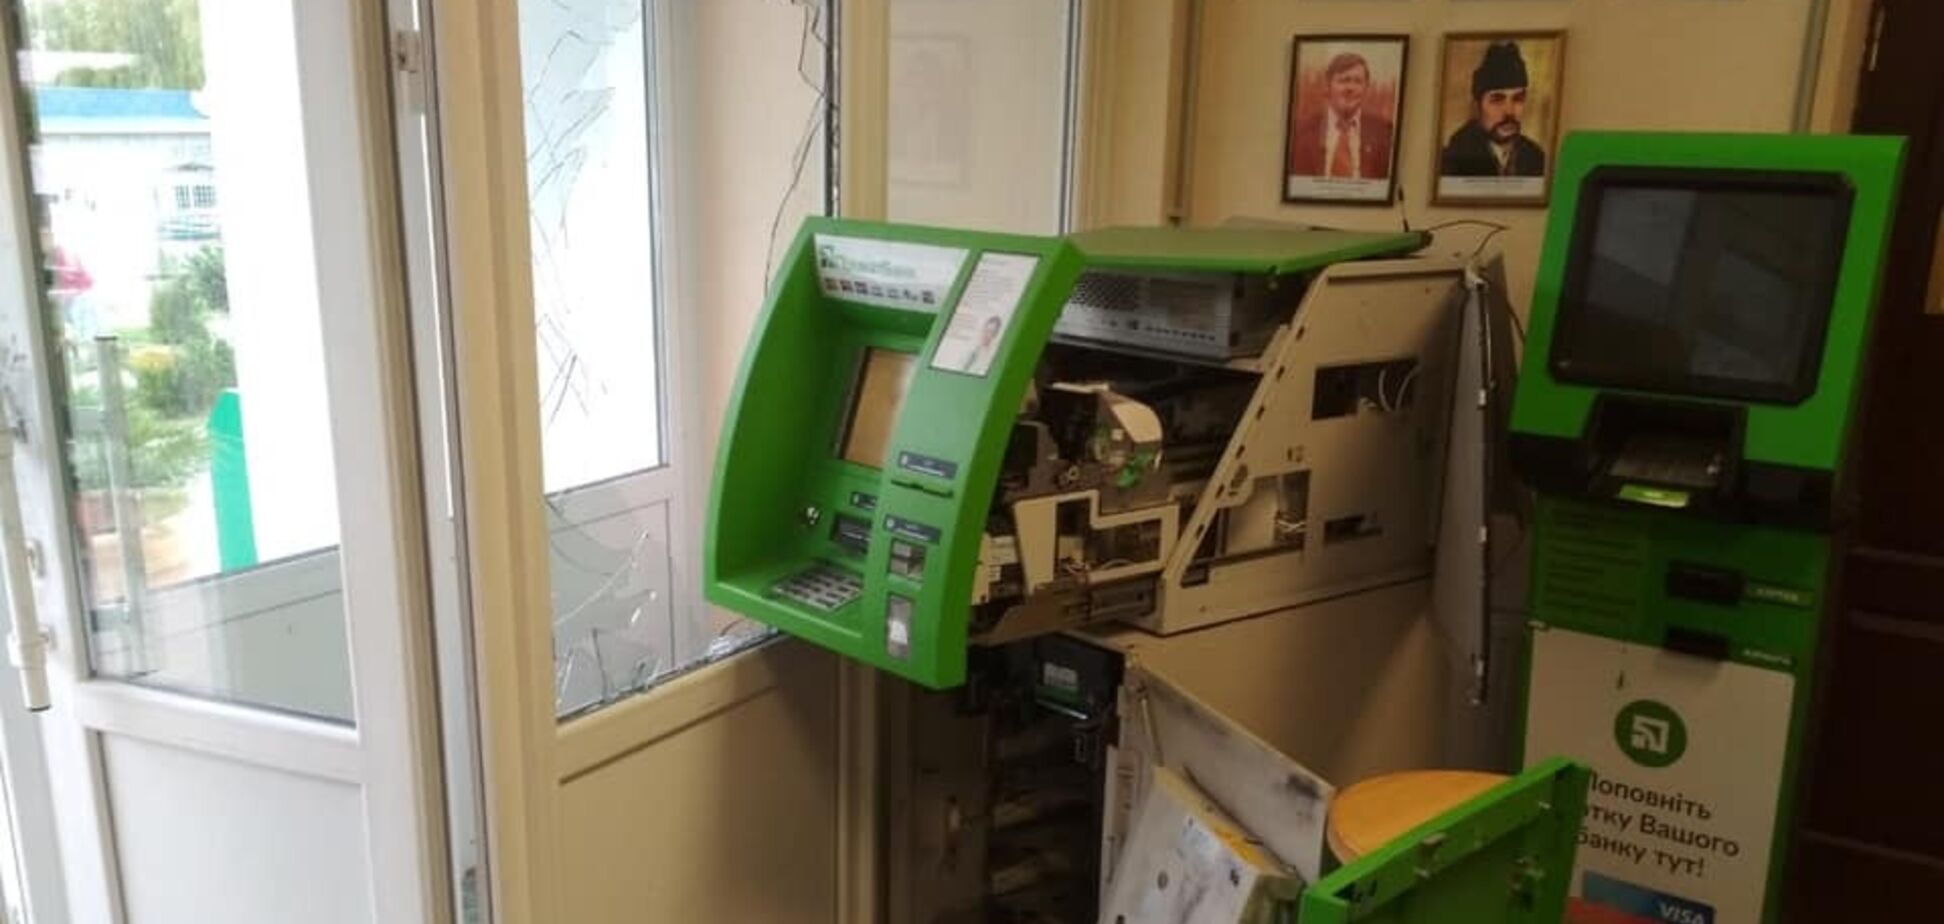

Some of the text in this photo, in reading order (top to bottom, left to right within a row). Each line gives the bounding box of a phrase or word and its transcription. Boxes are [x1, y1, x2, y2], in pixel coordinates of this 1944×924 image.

[1584, 804, 1740, 857] тку Вашого
[1653, 849, 1707, 878] тут!
[1657, 901, 1706, 924] VISA
